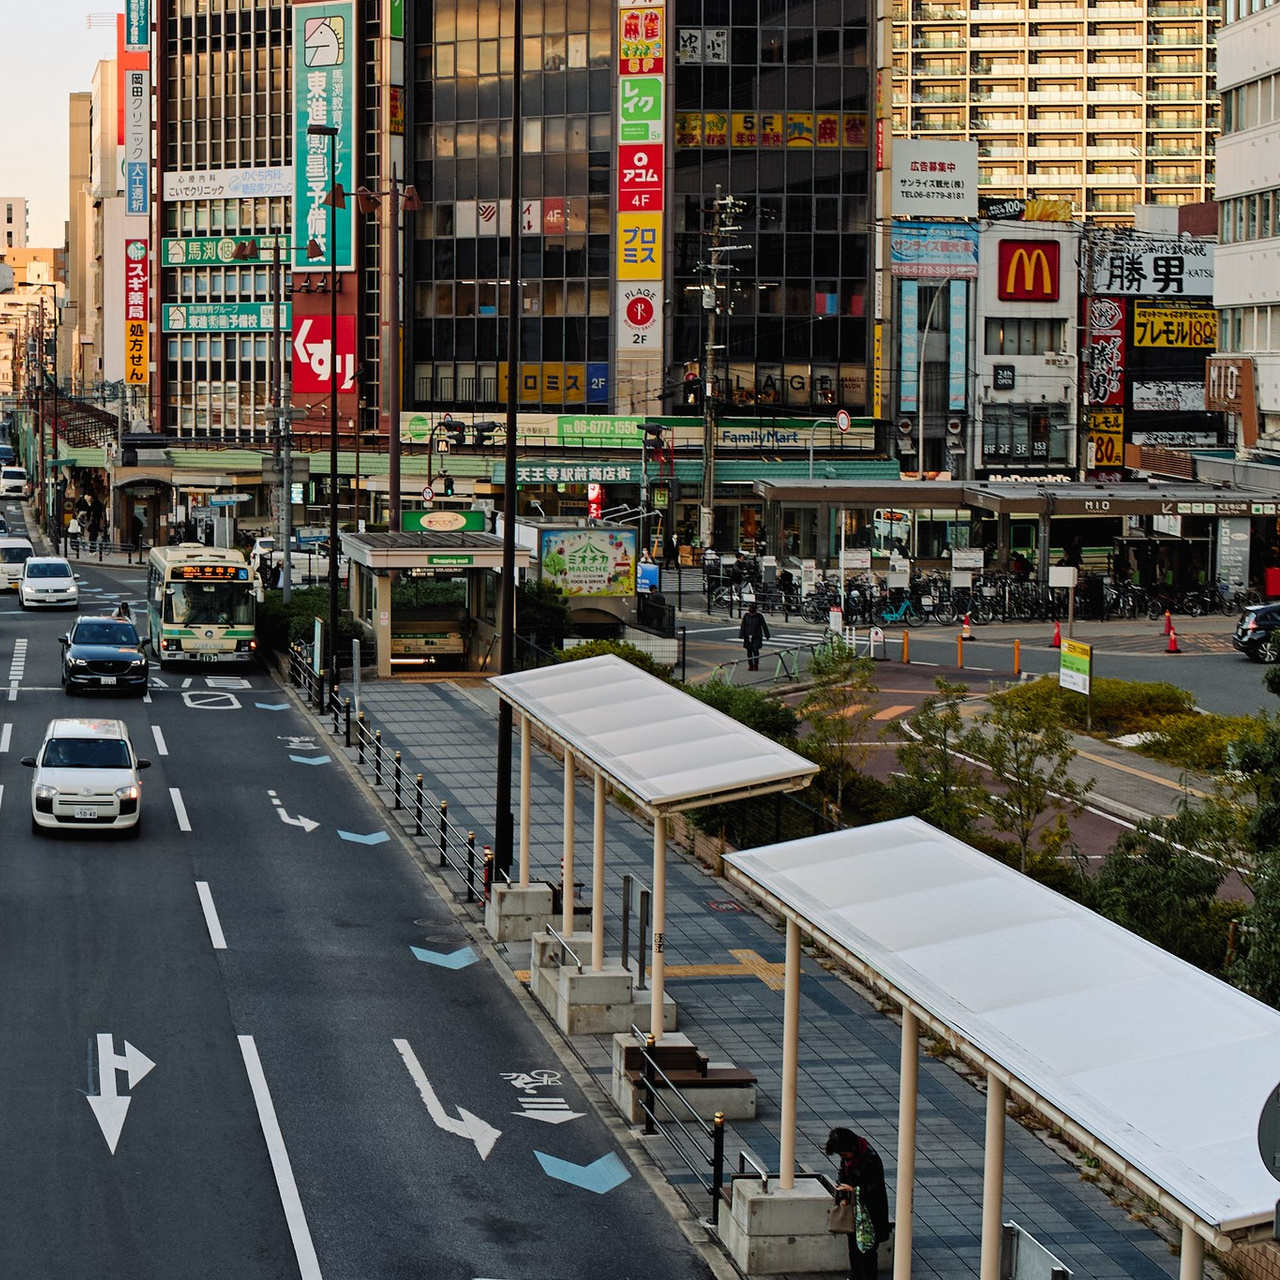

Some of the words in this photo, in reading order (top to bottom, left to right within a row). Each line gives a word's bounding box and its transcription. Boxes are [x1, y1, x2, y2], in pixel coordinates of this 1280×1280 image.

[622, 10, 661, 42] 麻雀
[628, 58, 655, 73] 5F
[131, 73, 144, 160] 岡田クリニック
[910, 161, 957, 173] 広告募集中
[178, 173, 217, 184] 心療内科
[622, 169, 659, 183] アコム
[131, 163, 144, 212] 人工透析
[168, 185, 225, 197] こいでクリニック
[631, 194, 650, 207] 4F
[546, 209, 562, 223] 4F
[622, 226, 657, 245] プロ
[622, 247, 656, 264] ミス
[1105, 253, 1185, 294] 勝男
[128, 262, 148, 320] スギ薬局
[624, 287, 657, 301] PLAGE
[632, 333, 648, 345] 2F
[129, 323, 144, 381] 処方せん
[293, 319, 355, 391] くすり
[591, 377, 606, 390] 2F
[722, 429, 799, 444] FamilyMart
[999, 444, 1010, 454] 2F
[1015, 444, 1027, 454] 3F
[1033, 441, 1047, 450] 153
[516, 466, 631, 482] 天王寺駅前商店街
[1084, 500, 1111, 510] MIO
[568, 553, 609, 566] ミオチカ
[568, 565, 609, 573] MARCHE
